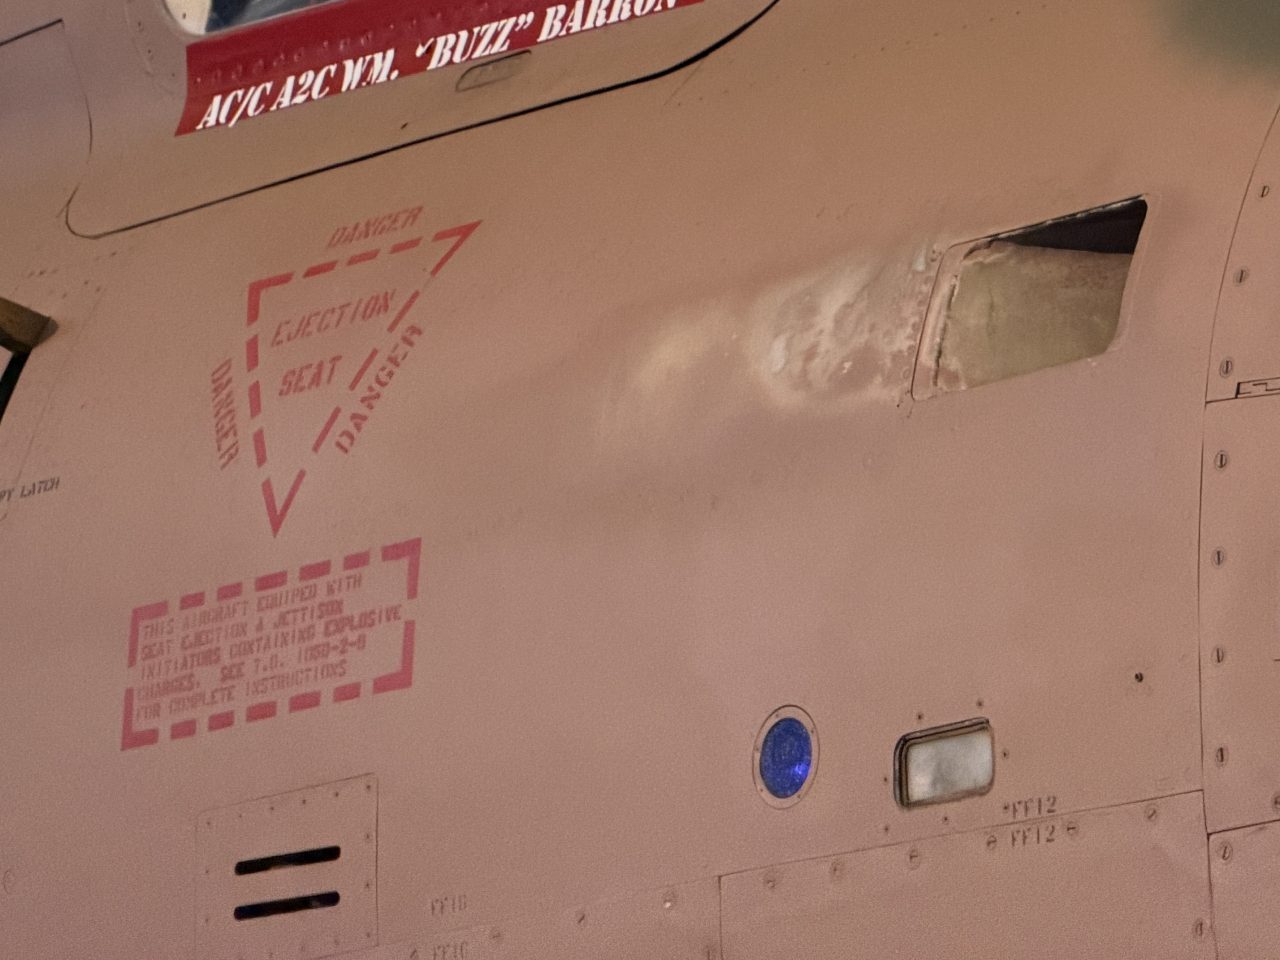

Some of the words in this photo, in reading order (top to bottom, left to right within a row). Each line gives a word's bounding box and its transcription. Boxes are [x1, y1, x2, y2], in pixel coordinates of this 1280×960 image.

[196, 81, 273, 129] AC/C
[270, 63, 337, 110] A2C
[341, 48, 399, 92] WM.
[326, 205, 423, 249] DANGER
[271, 288, 397, 347] EJECTION
[278, 355, 342, 397] SEAT
[335, 324, 423, 454] DANGER
[210, 358, 239, 471] DANGER
[143, 617, 174, 640] THIS
[229, 624, 316, 660] CONTAINING
[323, 603, 402, 638] EXPLOSIVE
[272, 598, 344, 630] JETTISON
[219, 661, 246, 684] SEE
[244, 657, 348, 697] INSTRUCTIONS
